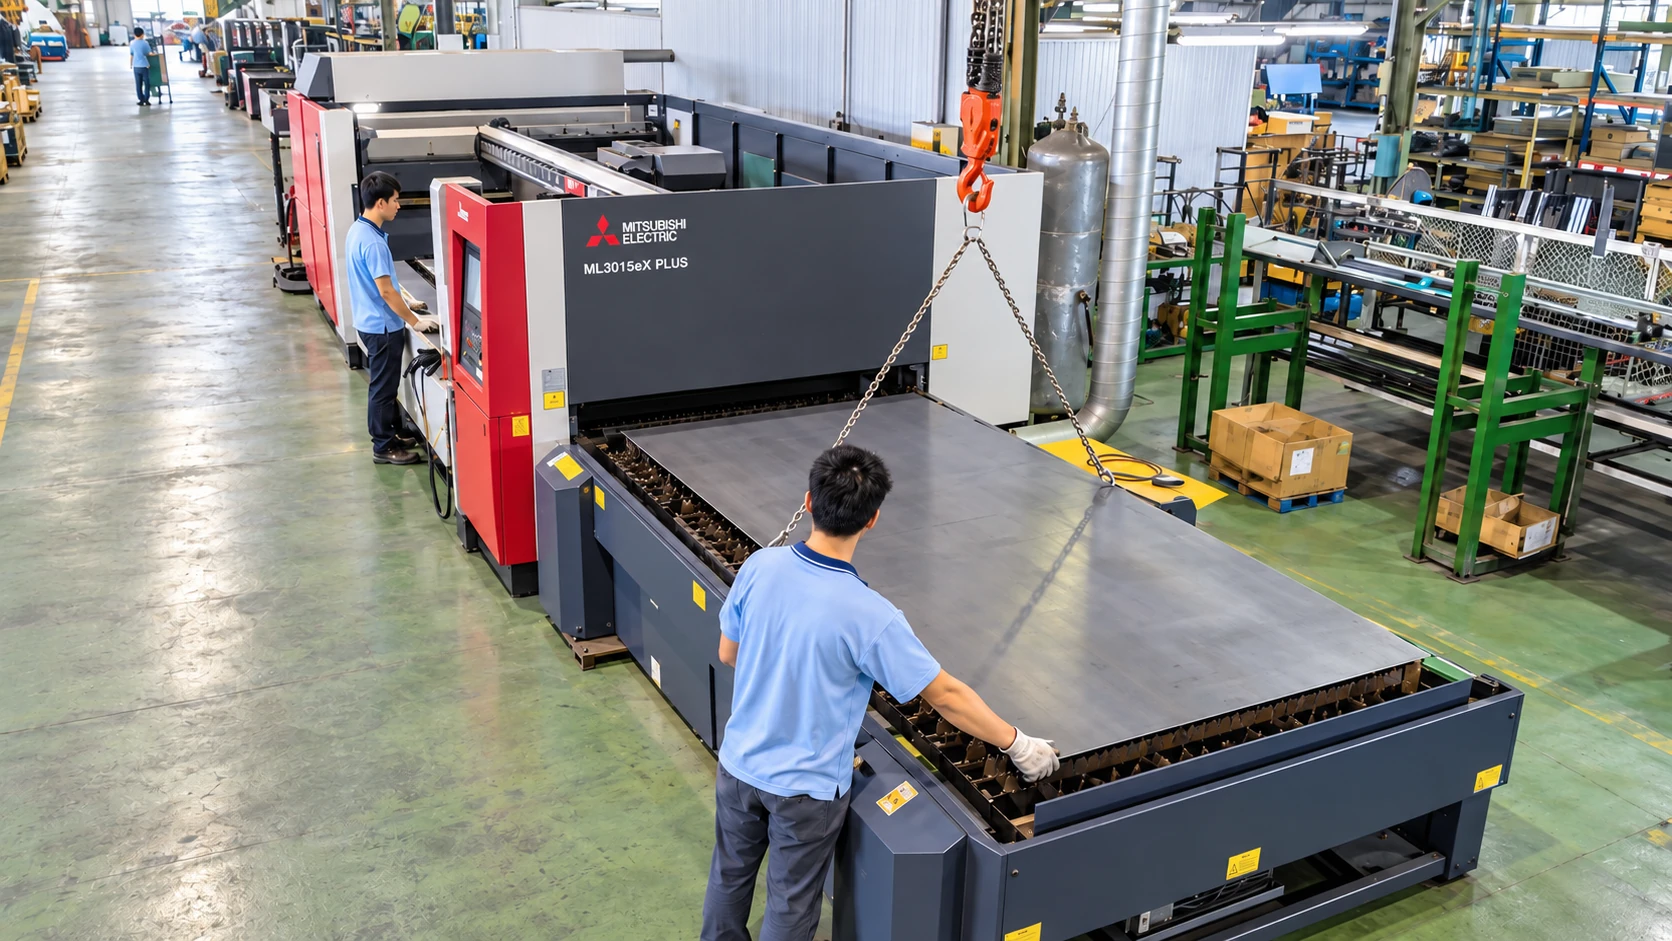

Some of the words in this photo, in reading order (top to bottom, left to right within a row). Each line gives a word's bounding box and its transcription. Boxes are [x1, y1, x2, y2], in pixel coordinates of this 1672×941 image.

[622, 219, 687, 233] MITSUBISHI
[622, 230, 678, 245] ELECTRIC
[584, 259, 652, 275] ML3015eX
[655, 256, 689, 270] PLUS
